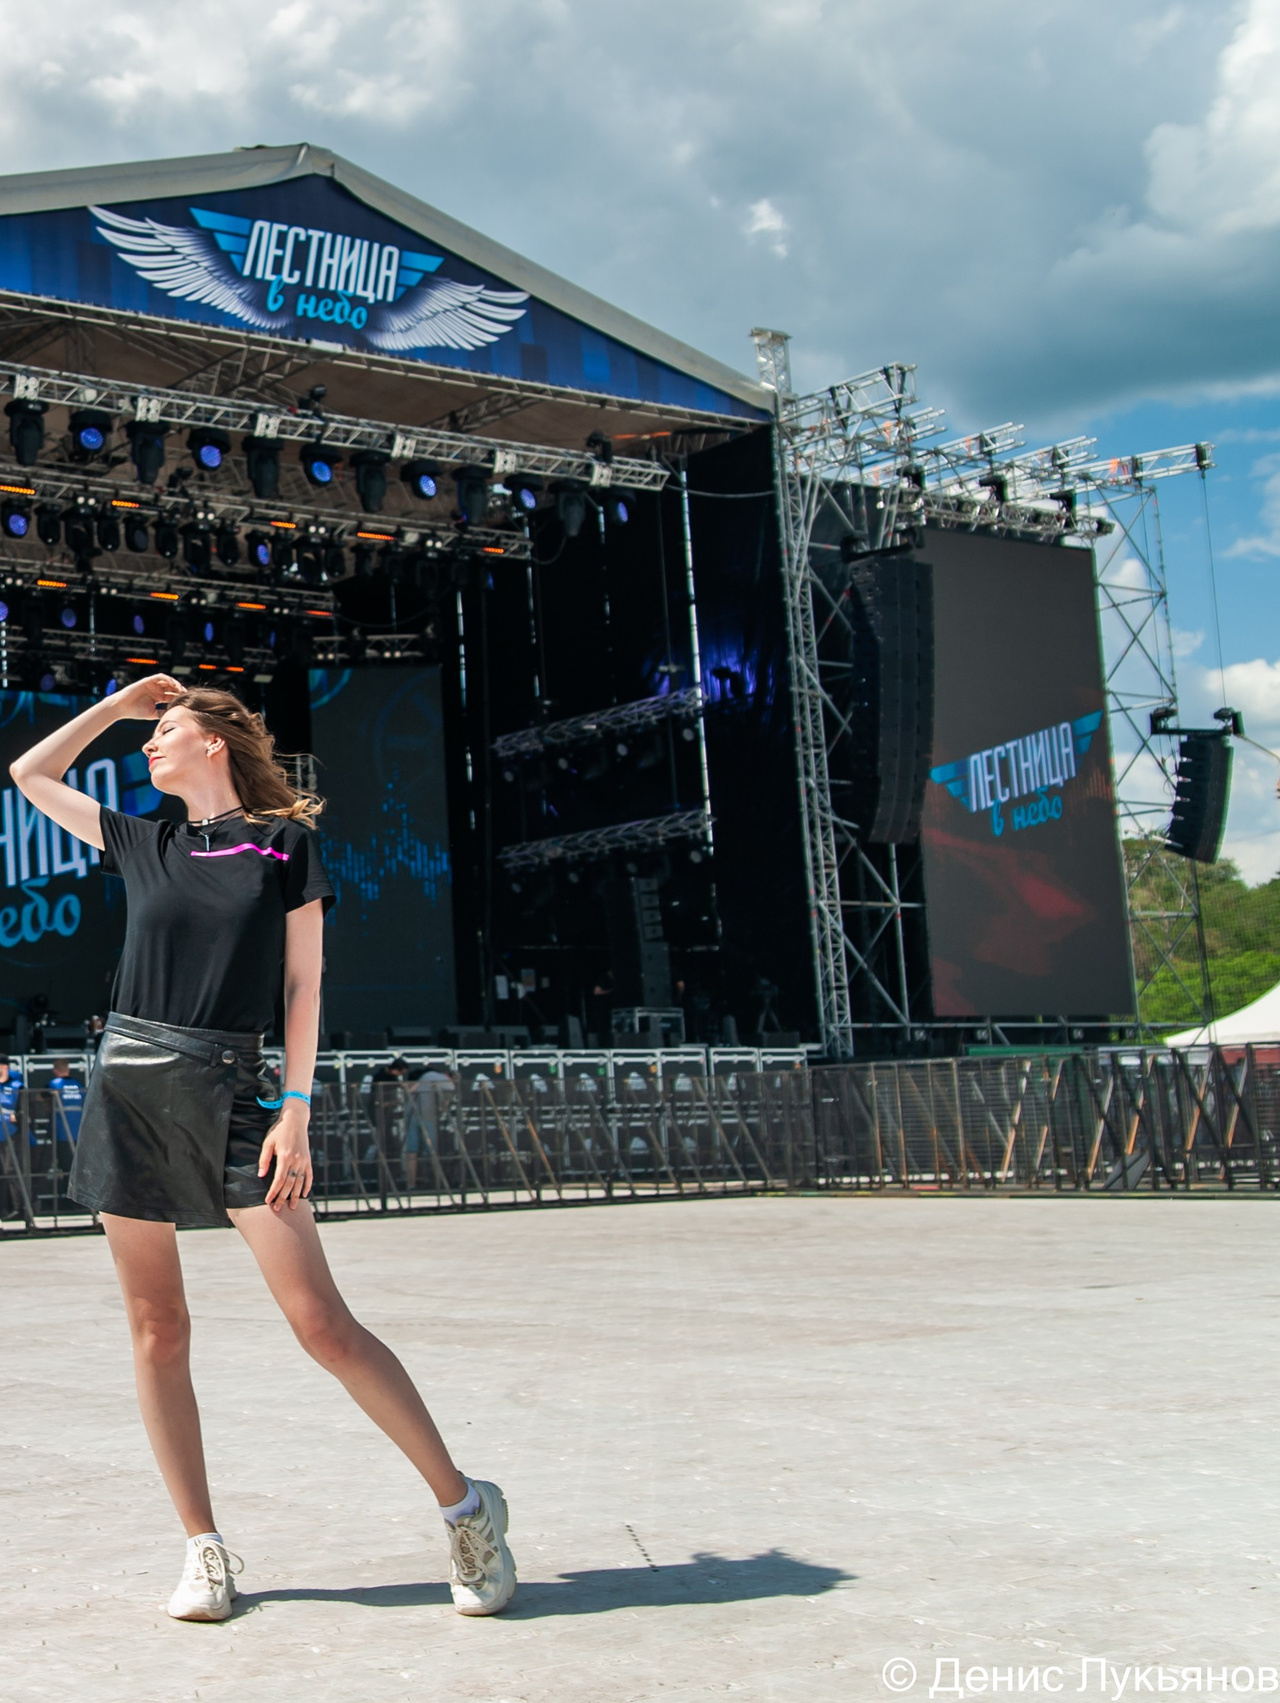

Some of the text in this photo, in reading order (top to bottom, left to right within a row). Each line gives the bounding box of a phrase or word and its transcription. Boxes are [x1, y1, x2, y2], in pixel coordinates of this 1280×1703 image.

[242, 220, 400, 303] ЛЕСТНИЦА
[267, 276, 368, 329] в небо
[969, 721, 1076, 813] ЛЕСТНИЦА
[991, 786, 1062, 837] в небо
